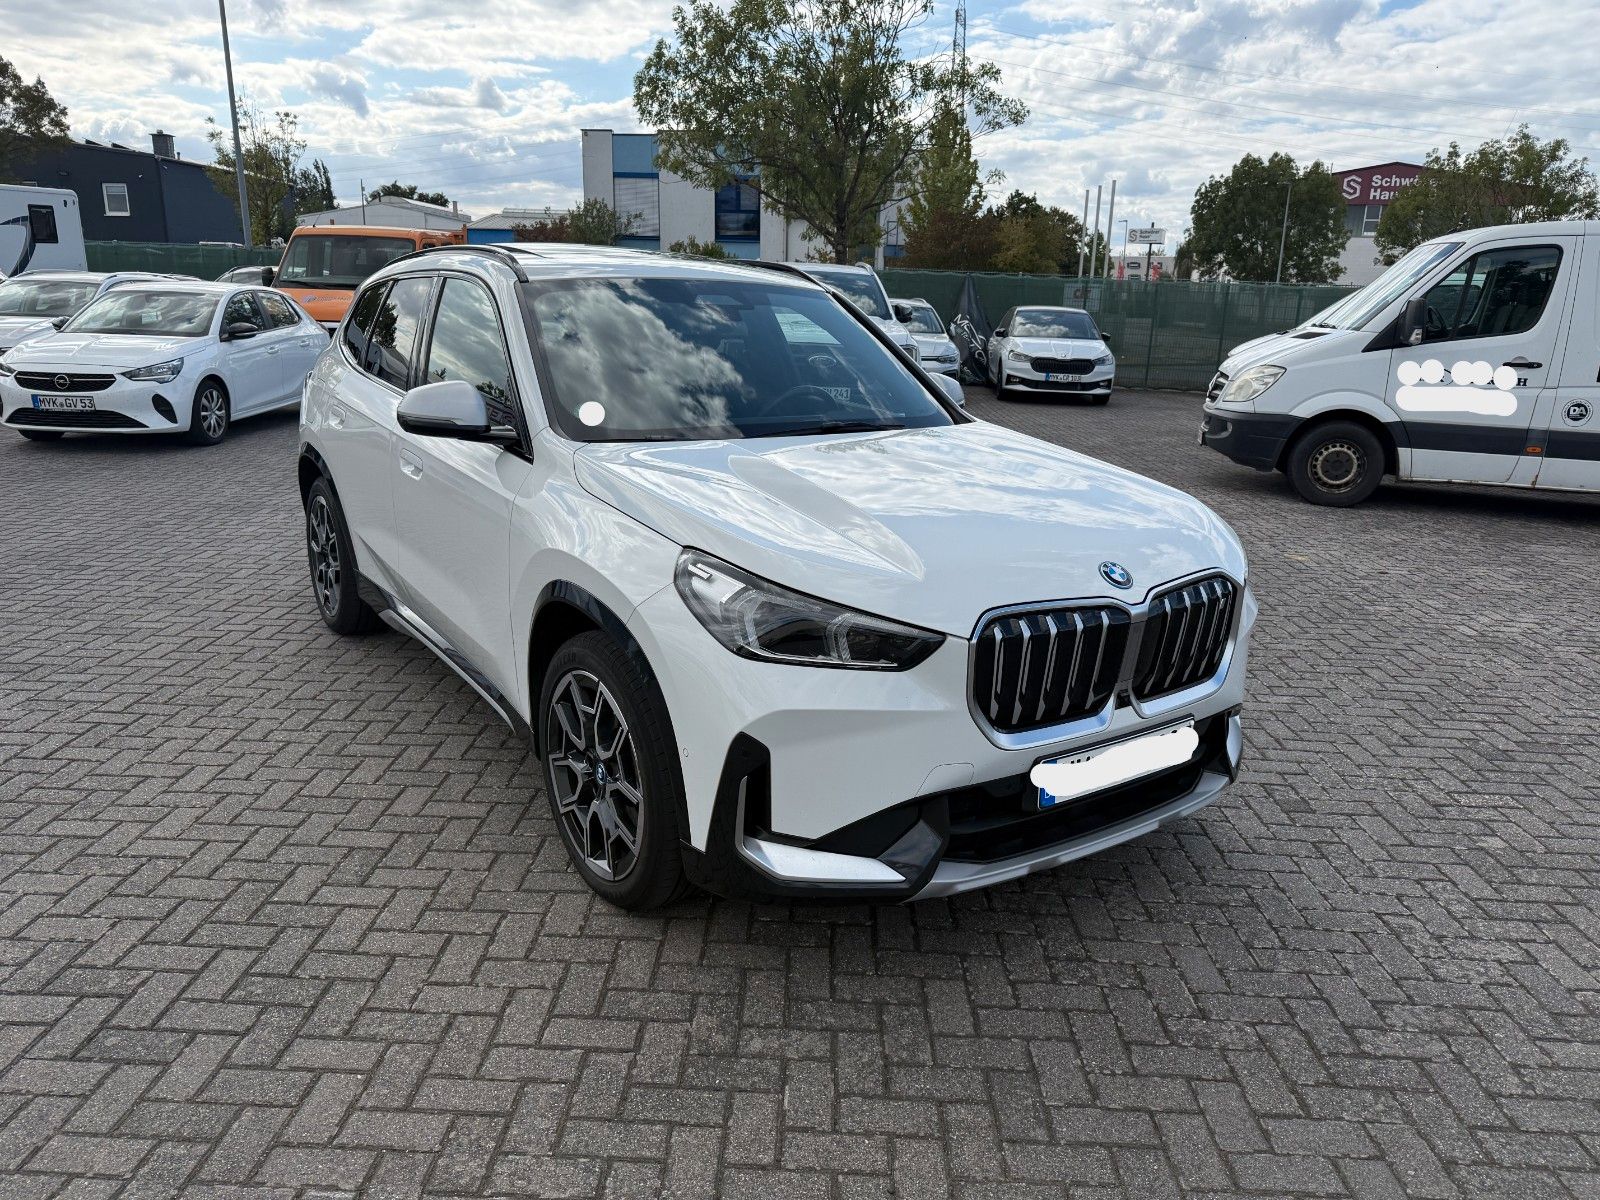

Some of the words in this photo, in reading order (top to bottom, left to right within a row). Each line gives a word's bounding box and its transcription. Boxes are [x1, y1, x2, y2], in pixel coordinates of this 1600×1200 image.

[38, 397, 57, 408] MYK
[64, 398, 78, 408] GV
[80, 398, 93, 409] 53
